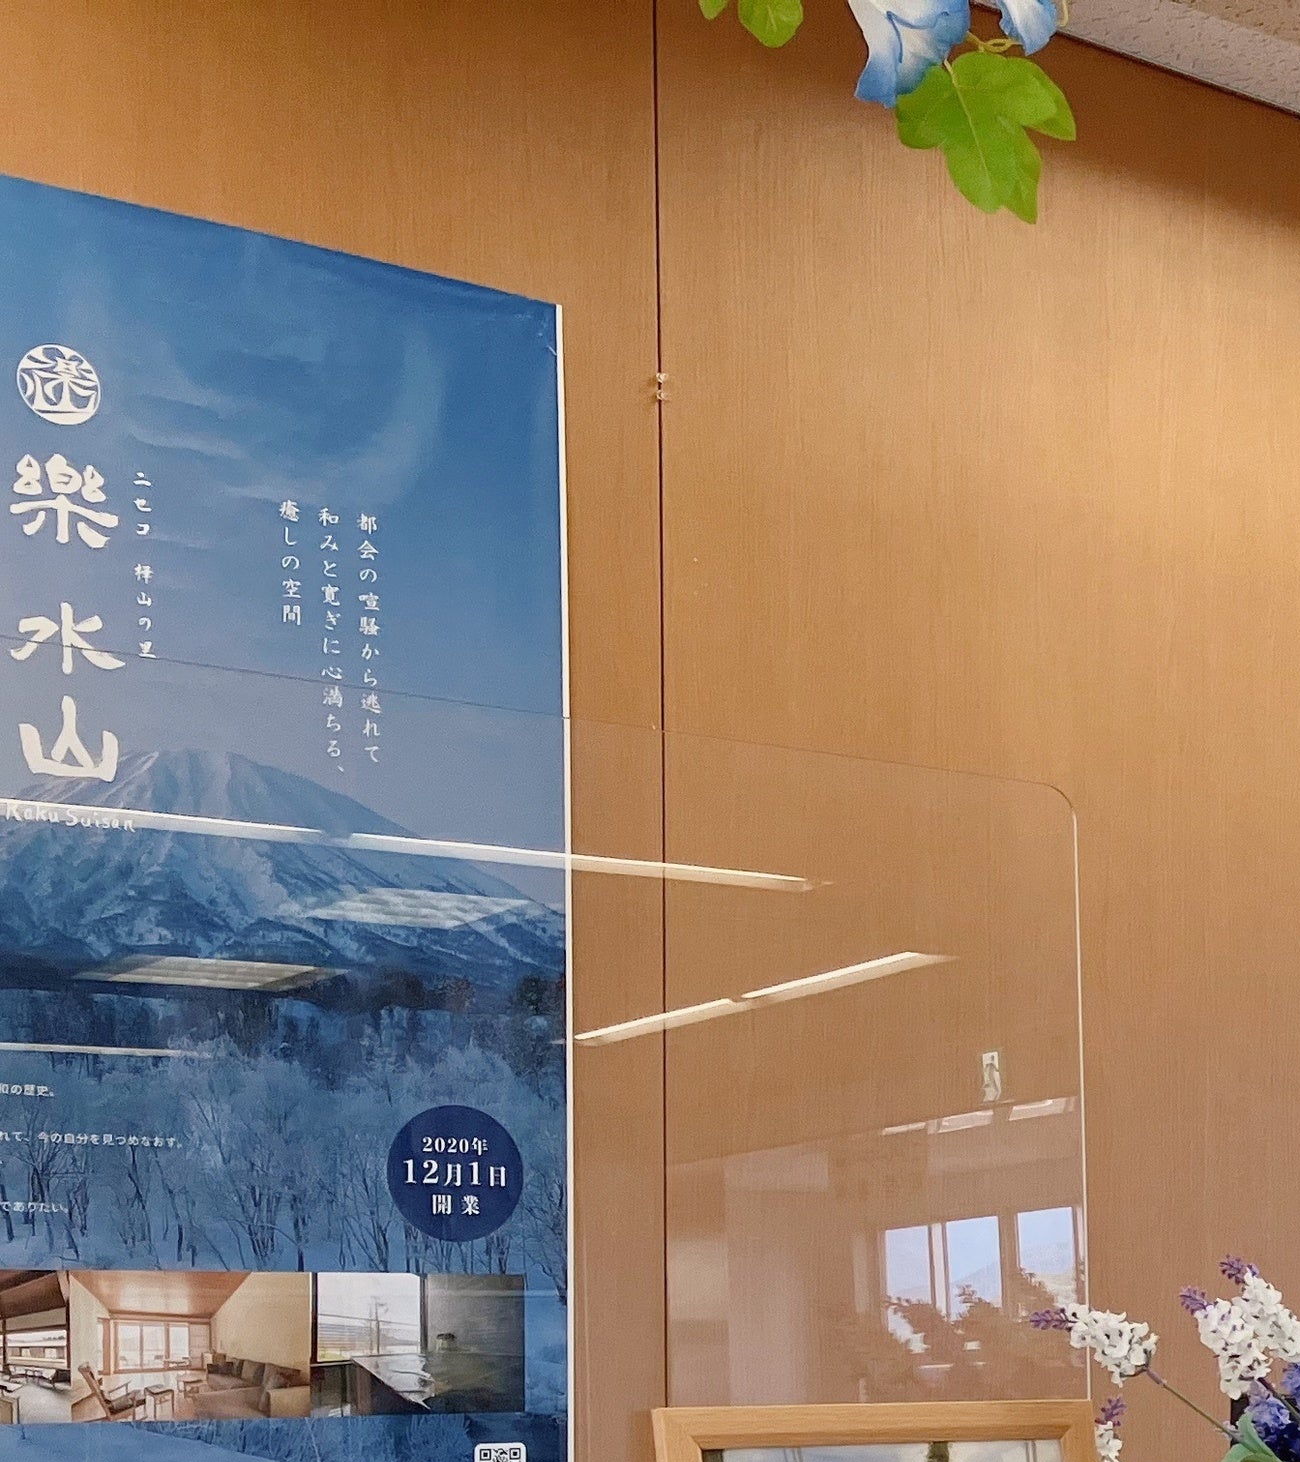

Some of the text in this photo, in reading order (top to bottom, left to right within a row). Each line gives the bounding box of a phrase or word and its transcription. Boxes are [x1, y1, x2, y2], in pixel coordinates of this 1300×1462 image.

[278, 499, 302, 626] 癒しの空間
[65, 807, 136, 834] Suisan
[422, 1136, 489, 1156] 2020年
[402, 1159, 507, 1188] 12月1日
[432, 1194, 480, 1216] 開業
